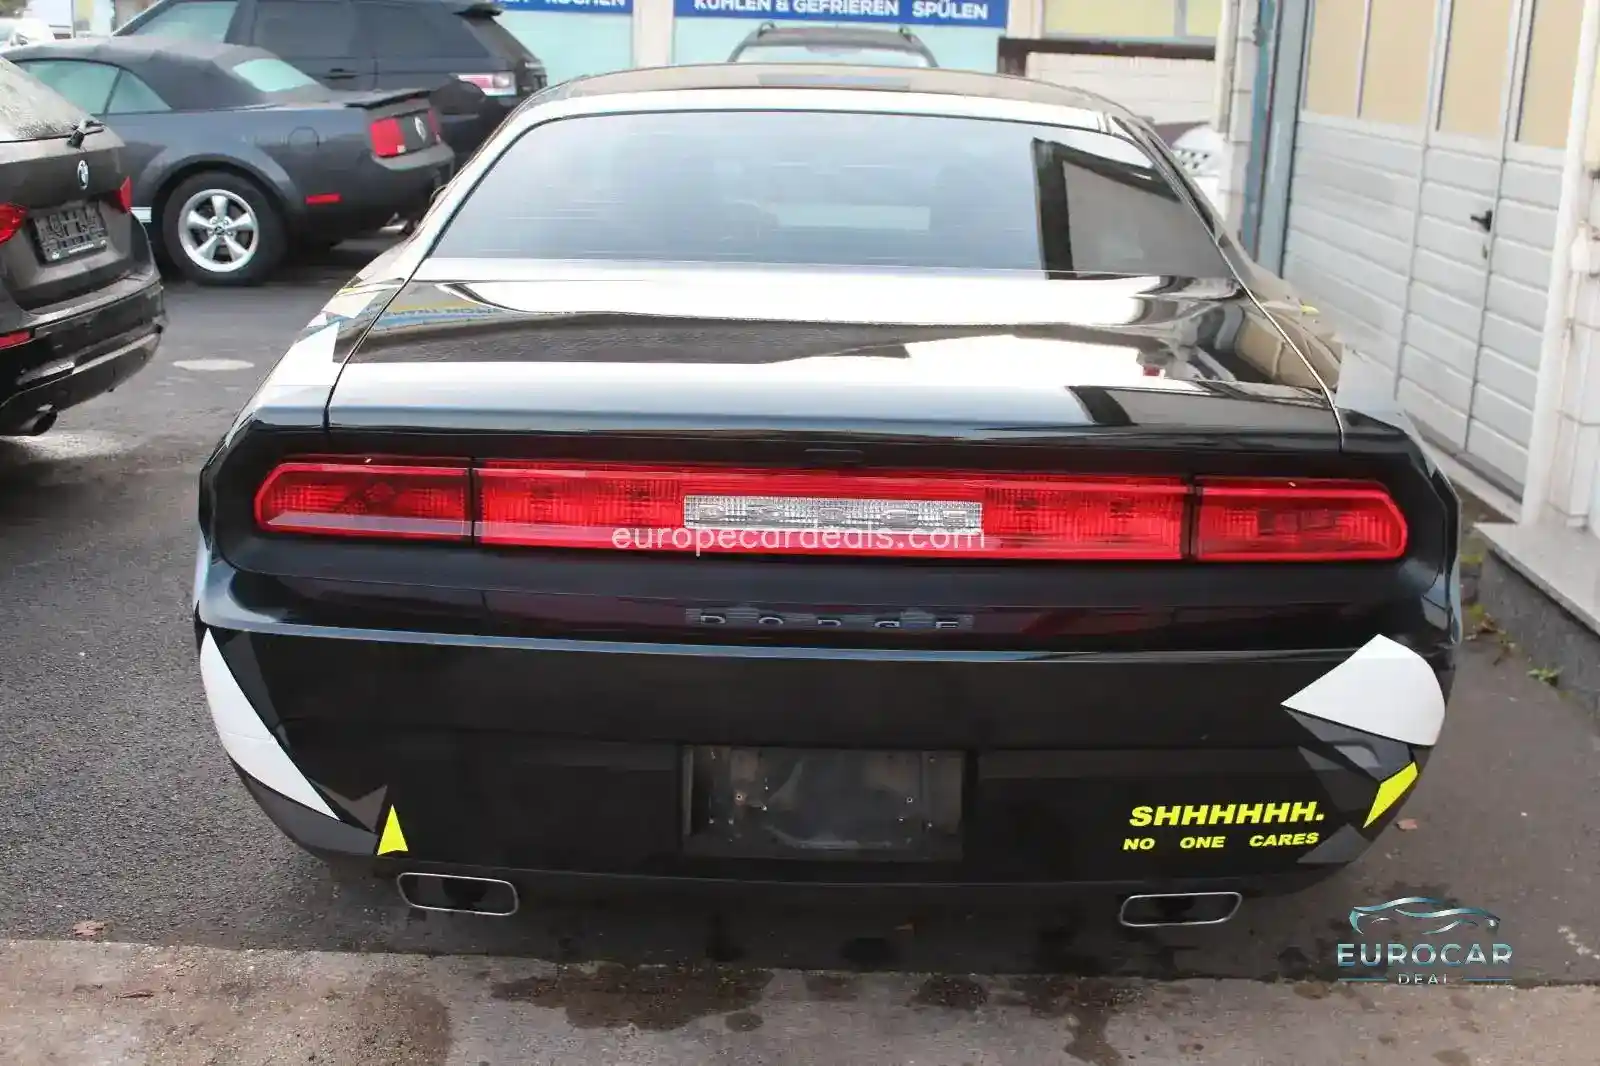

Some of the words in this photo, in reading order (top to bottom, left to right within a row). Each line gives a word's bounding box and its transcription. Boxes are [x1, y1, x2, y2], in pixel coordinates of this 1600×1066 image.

[793, 0, 899, 16] GEFRIEREN
[912, 0, 989, 20] SPÜLEN
[1129, 801, 1325, 827] SHHHHHH.
[1123, 838, 1156, 850] NO
[1180, 836, 1226, 849] ONE
[1249, 832, 1319, 847] CARES
